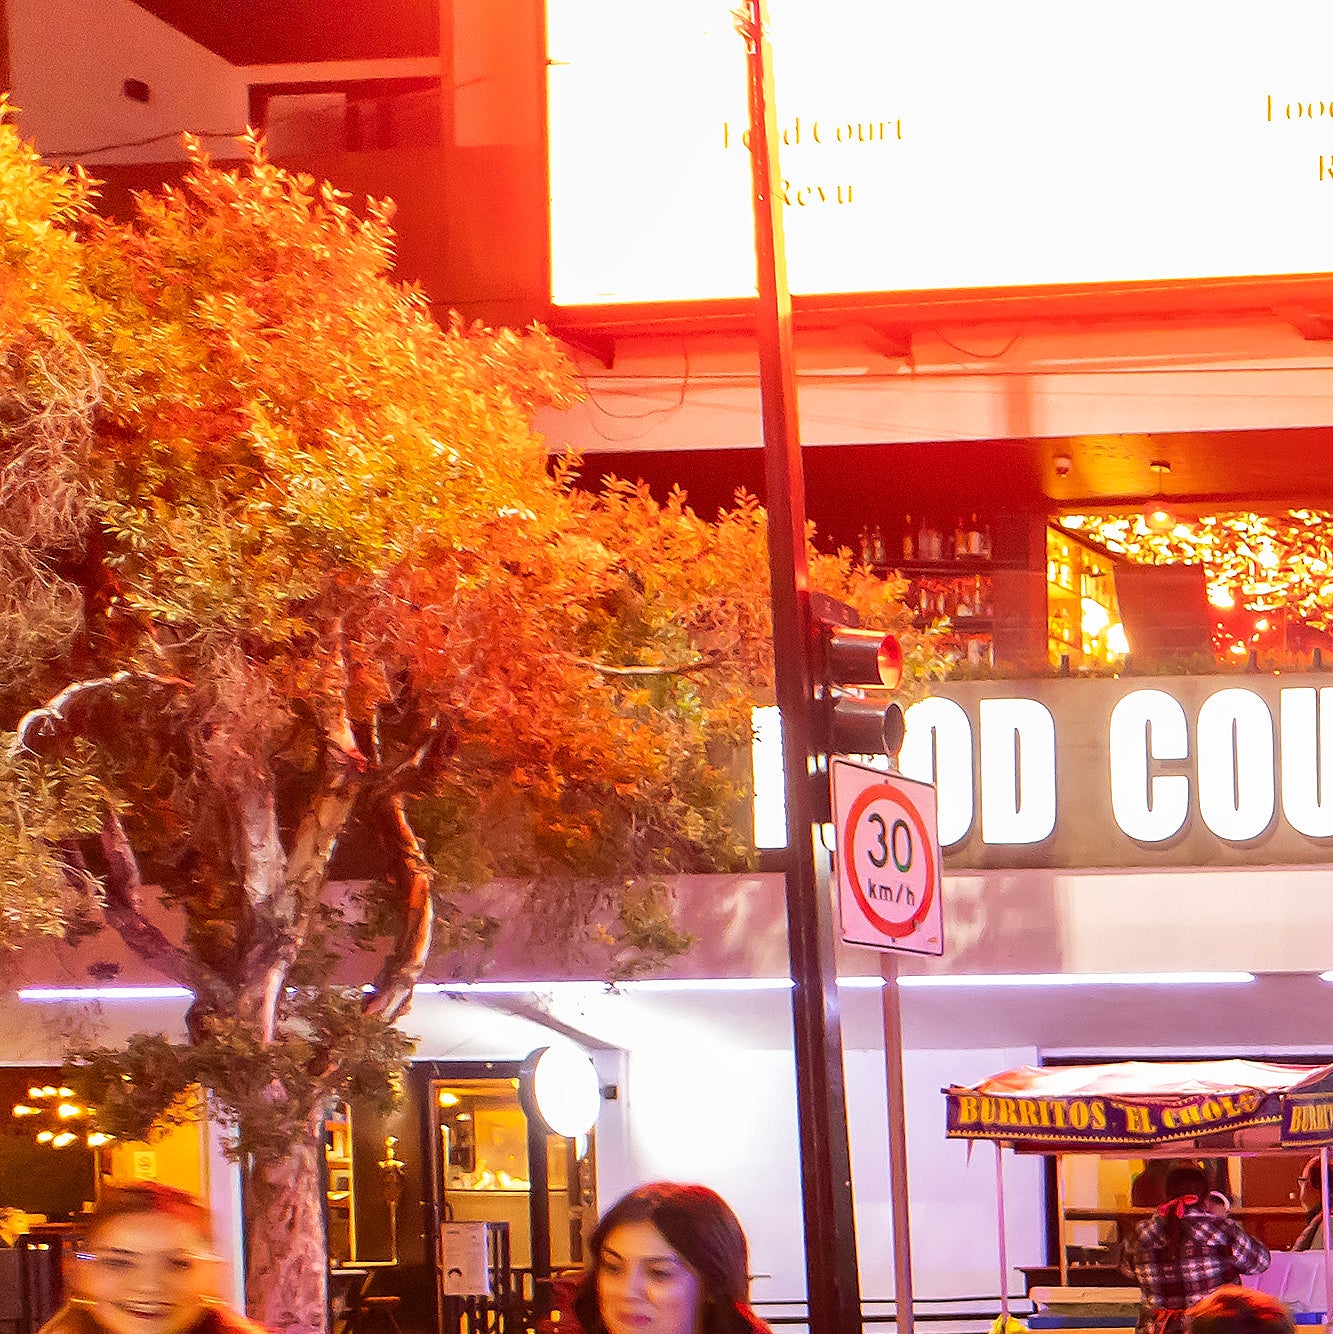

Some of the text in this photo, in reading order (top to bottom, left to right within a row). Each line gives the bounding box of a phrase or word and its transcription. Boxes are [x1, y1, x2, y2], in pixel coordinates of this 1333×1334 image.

[866, 812, 913, 874] 30
[866, 878, 916, 907] km/h
[958, 1095, 1107, 1130] BURRITOS
